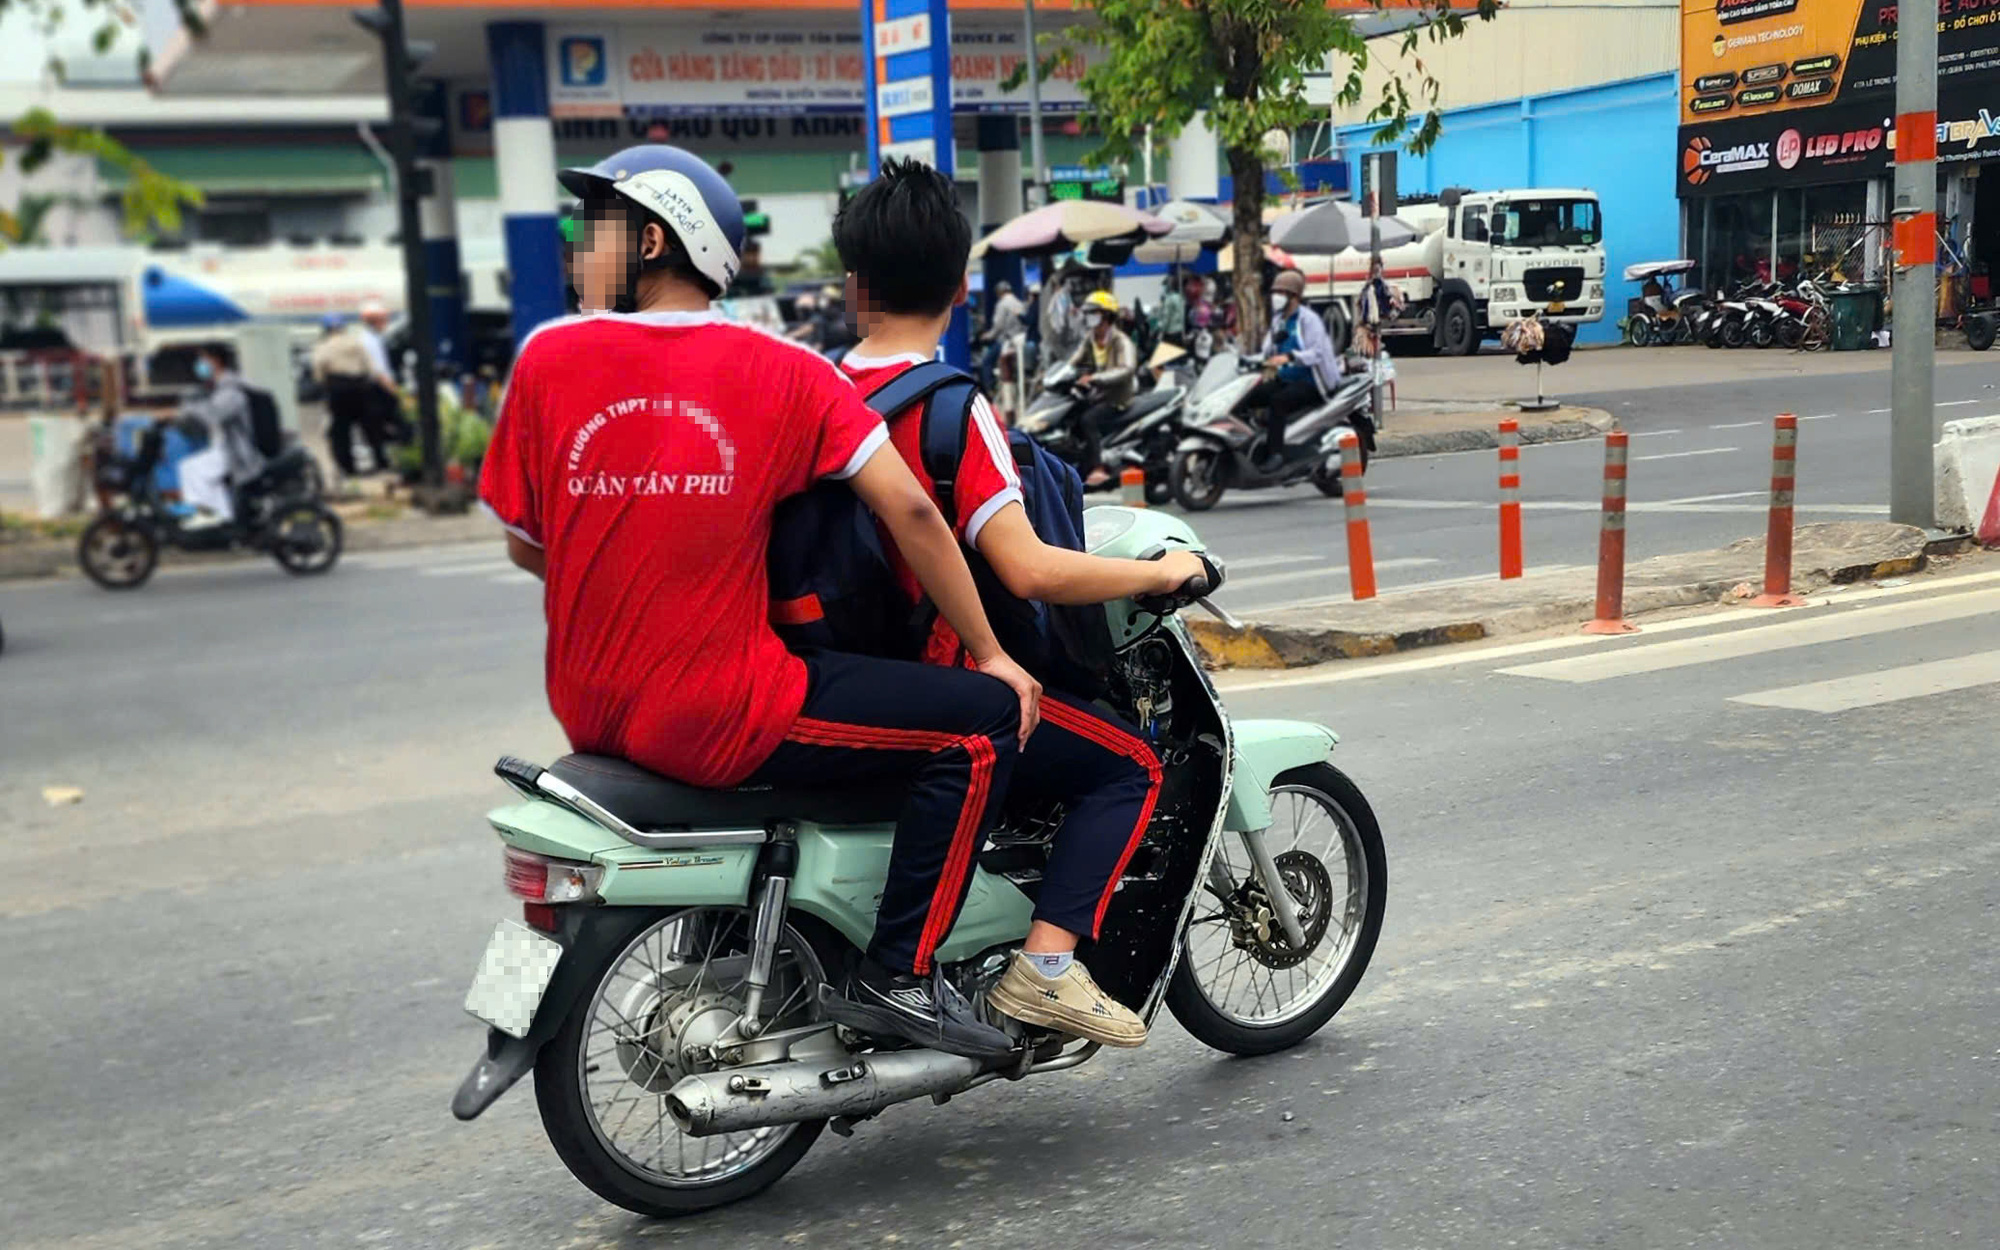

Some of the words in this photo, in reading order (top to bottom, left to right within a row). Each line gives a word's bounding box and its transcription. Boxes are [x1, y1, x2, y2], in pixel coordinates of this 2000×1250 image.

[1728, 35, 1758, 48] GERMAN
[1757, 24, 1804, 42] TECHNOLOGY
[668, 51, 716, 82] HÀNG
[1792, 80, 1821, 97] DOMAX
[1700, 142, 1770, 166] CeraMAX
[1780, 138, 1800, 161] LP
[1805, 131, 1840, 159] LED
[1841, 127, 1882, 155] PRO
[664, 188, 694, 214] LATIN
[1526, 258, 1584, 268] HYUNDAI
[606, 397, 649, 419] THPT
[633, 470, 679, 495] TÂN
